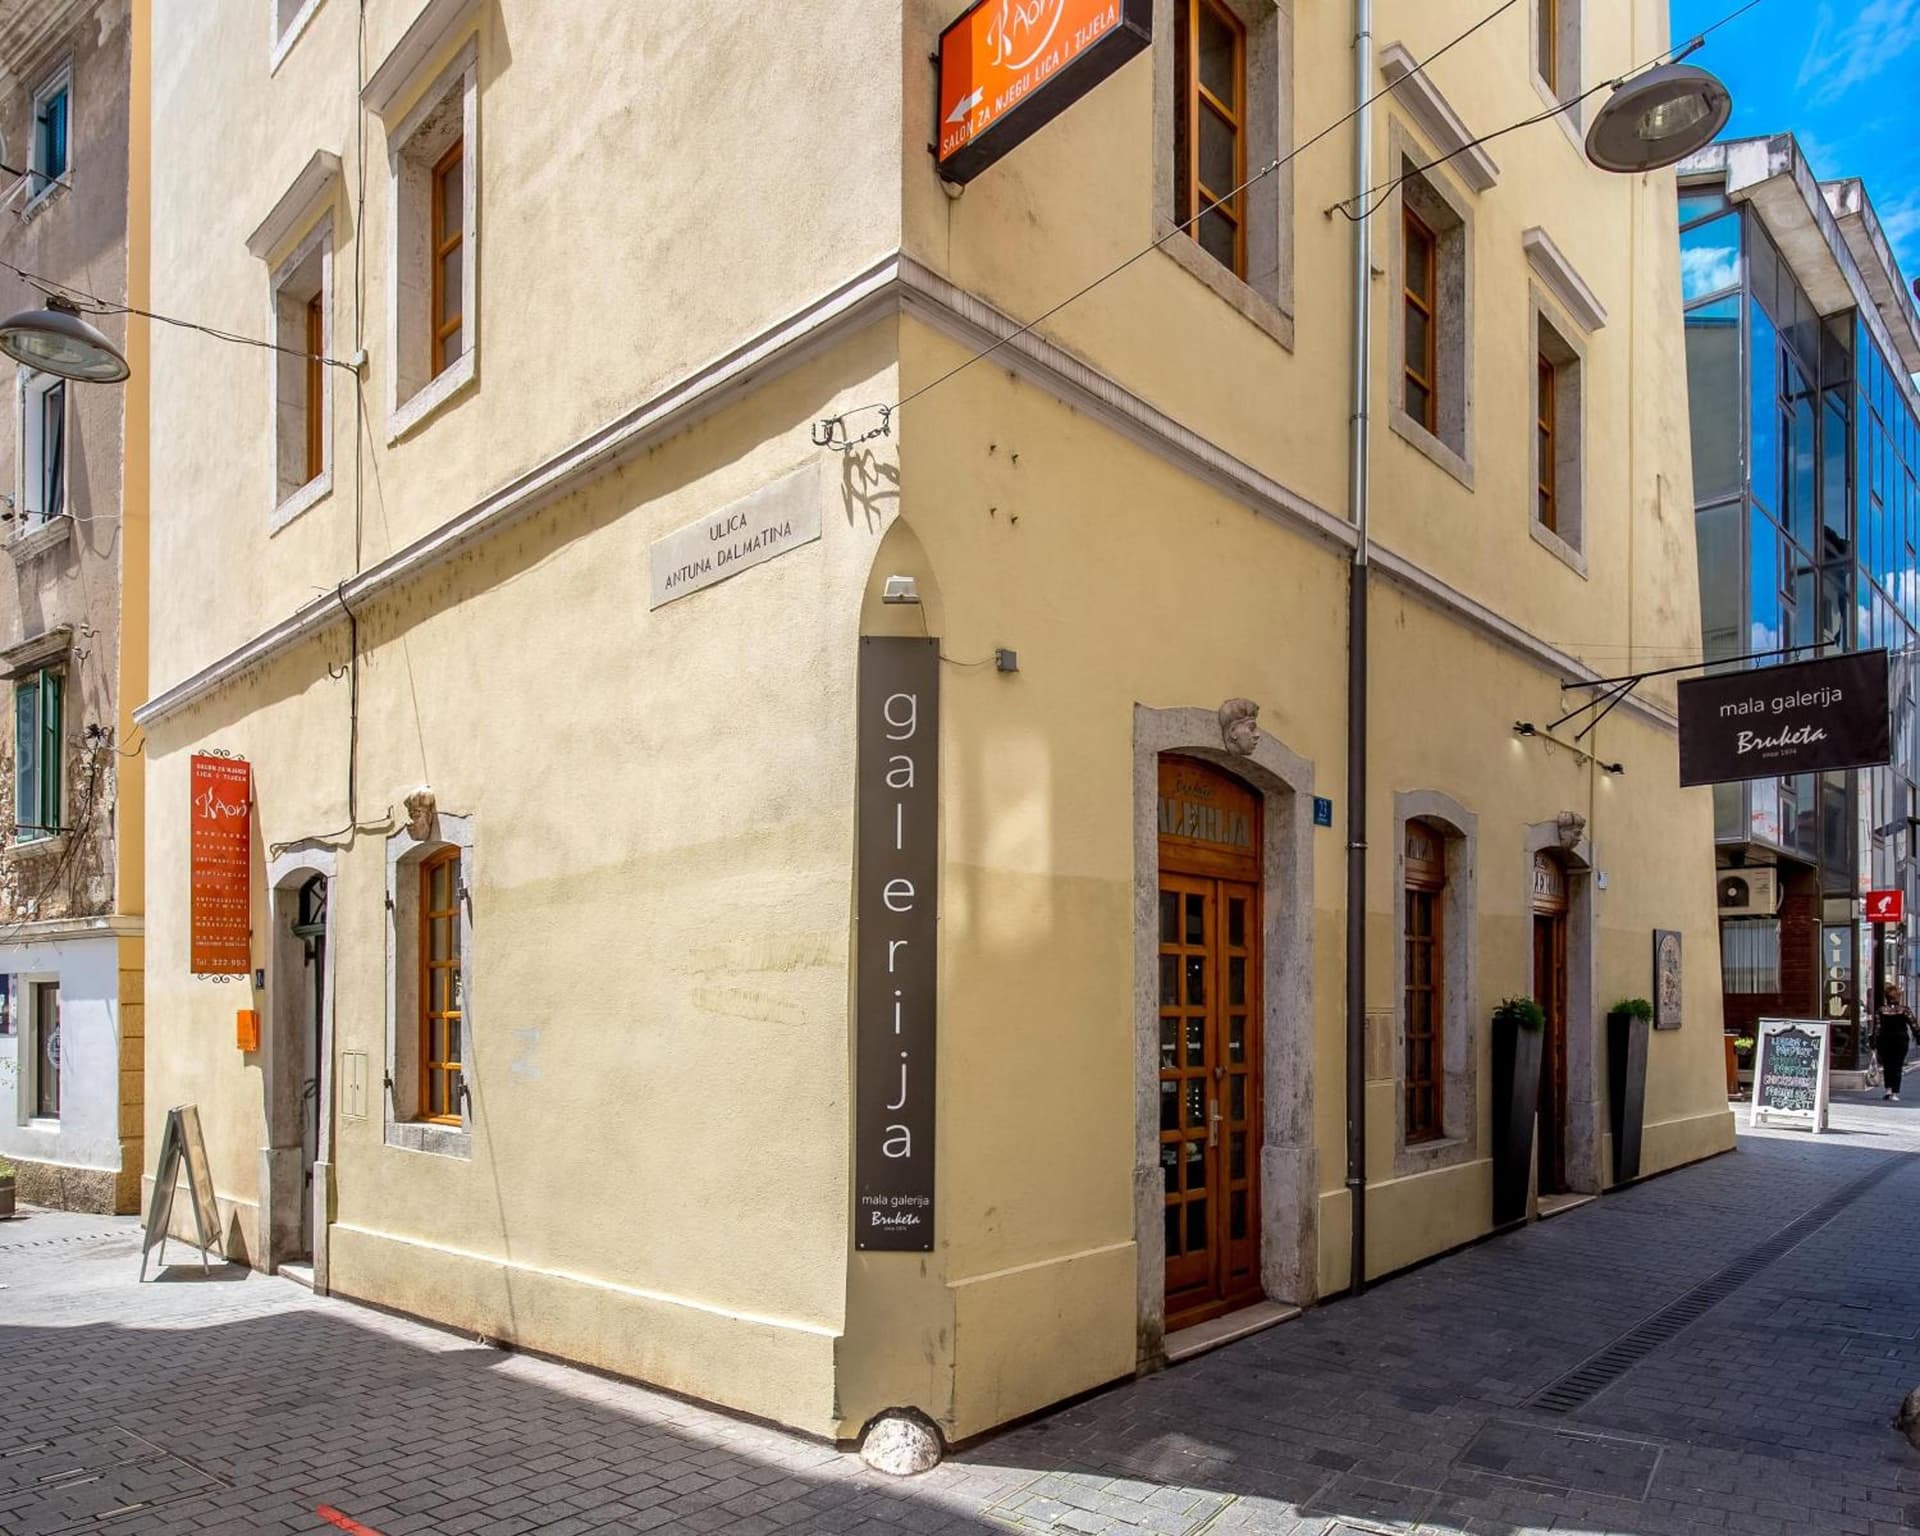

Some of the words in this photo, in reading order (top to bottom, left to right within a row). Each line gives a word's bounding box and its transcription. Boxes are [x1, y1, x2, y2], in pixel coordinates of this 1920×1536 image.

[943, 120, 973, 154] SALON
[978, 106, 991, 127] ZA
[995, 76, 1030, 111] NJEGU
[1035, 50, 1060, 82] LICA
[1064, 41, 1069, 58] I
[1074, 5, 1115, 49] TIJELA
[709, 512, 748, 541] ULICA
[664, 557, 713, 590] ANTUNA
[717, 521, 793, 567] DALMATINA
[1719, 697, 1766, 718] mala
[1771, 686, 1843, 714] galerija
[1737, 724, 1828, 755] Bruketa
[881, 692, 918, 1159] galerija
[862, 1194, 888, 1205] mala
[890, 1194, 930, 1208] galerija
[871, 1211, 921, 1226] Bruketa
